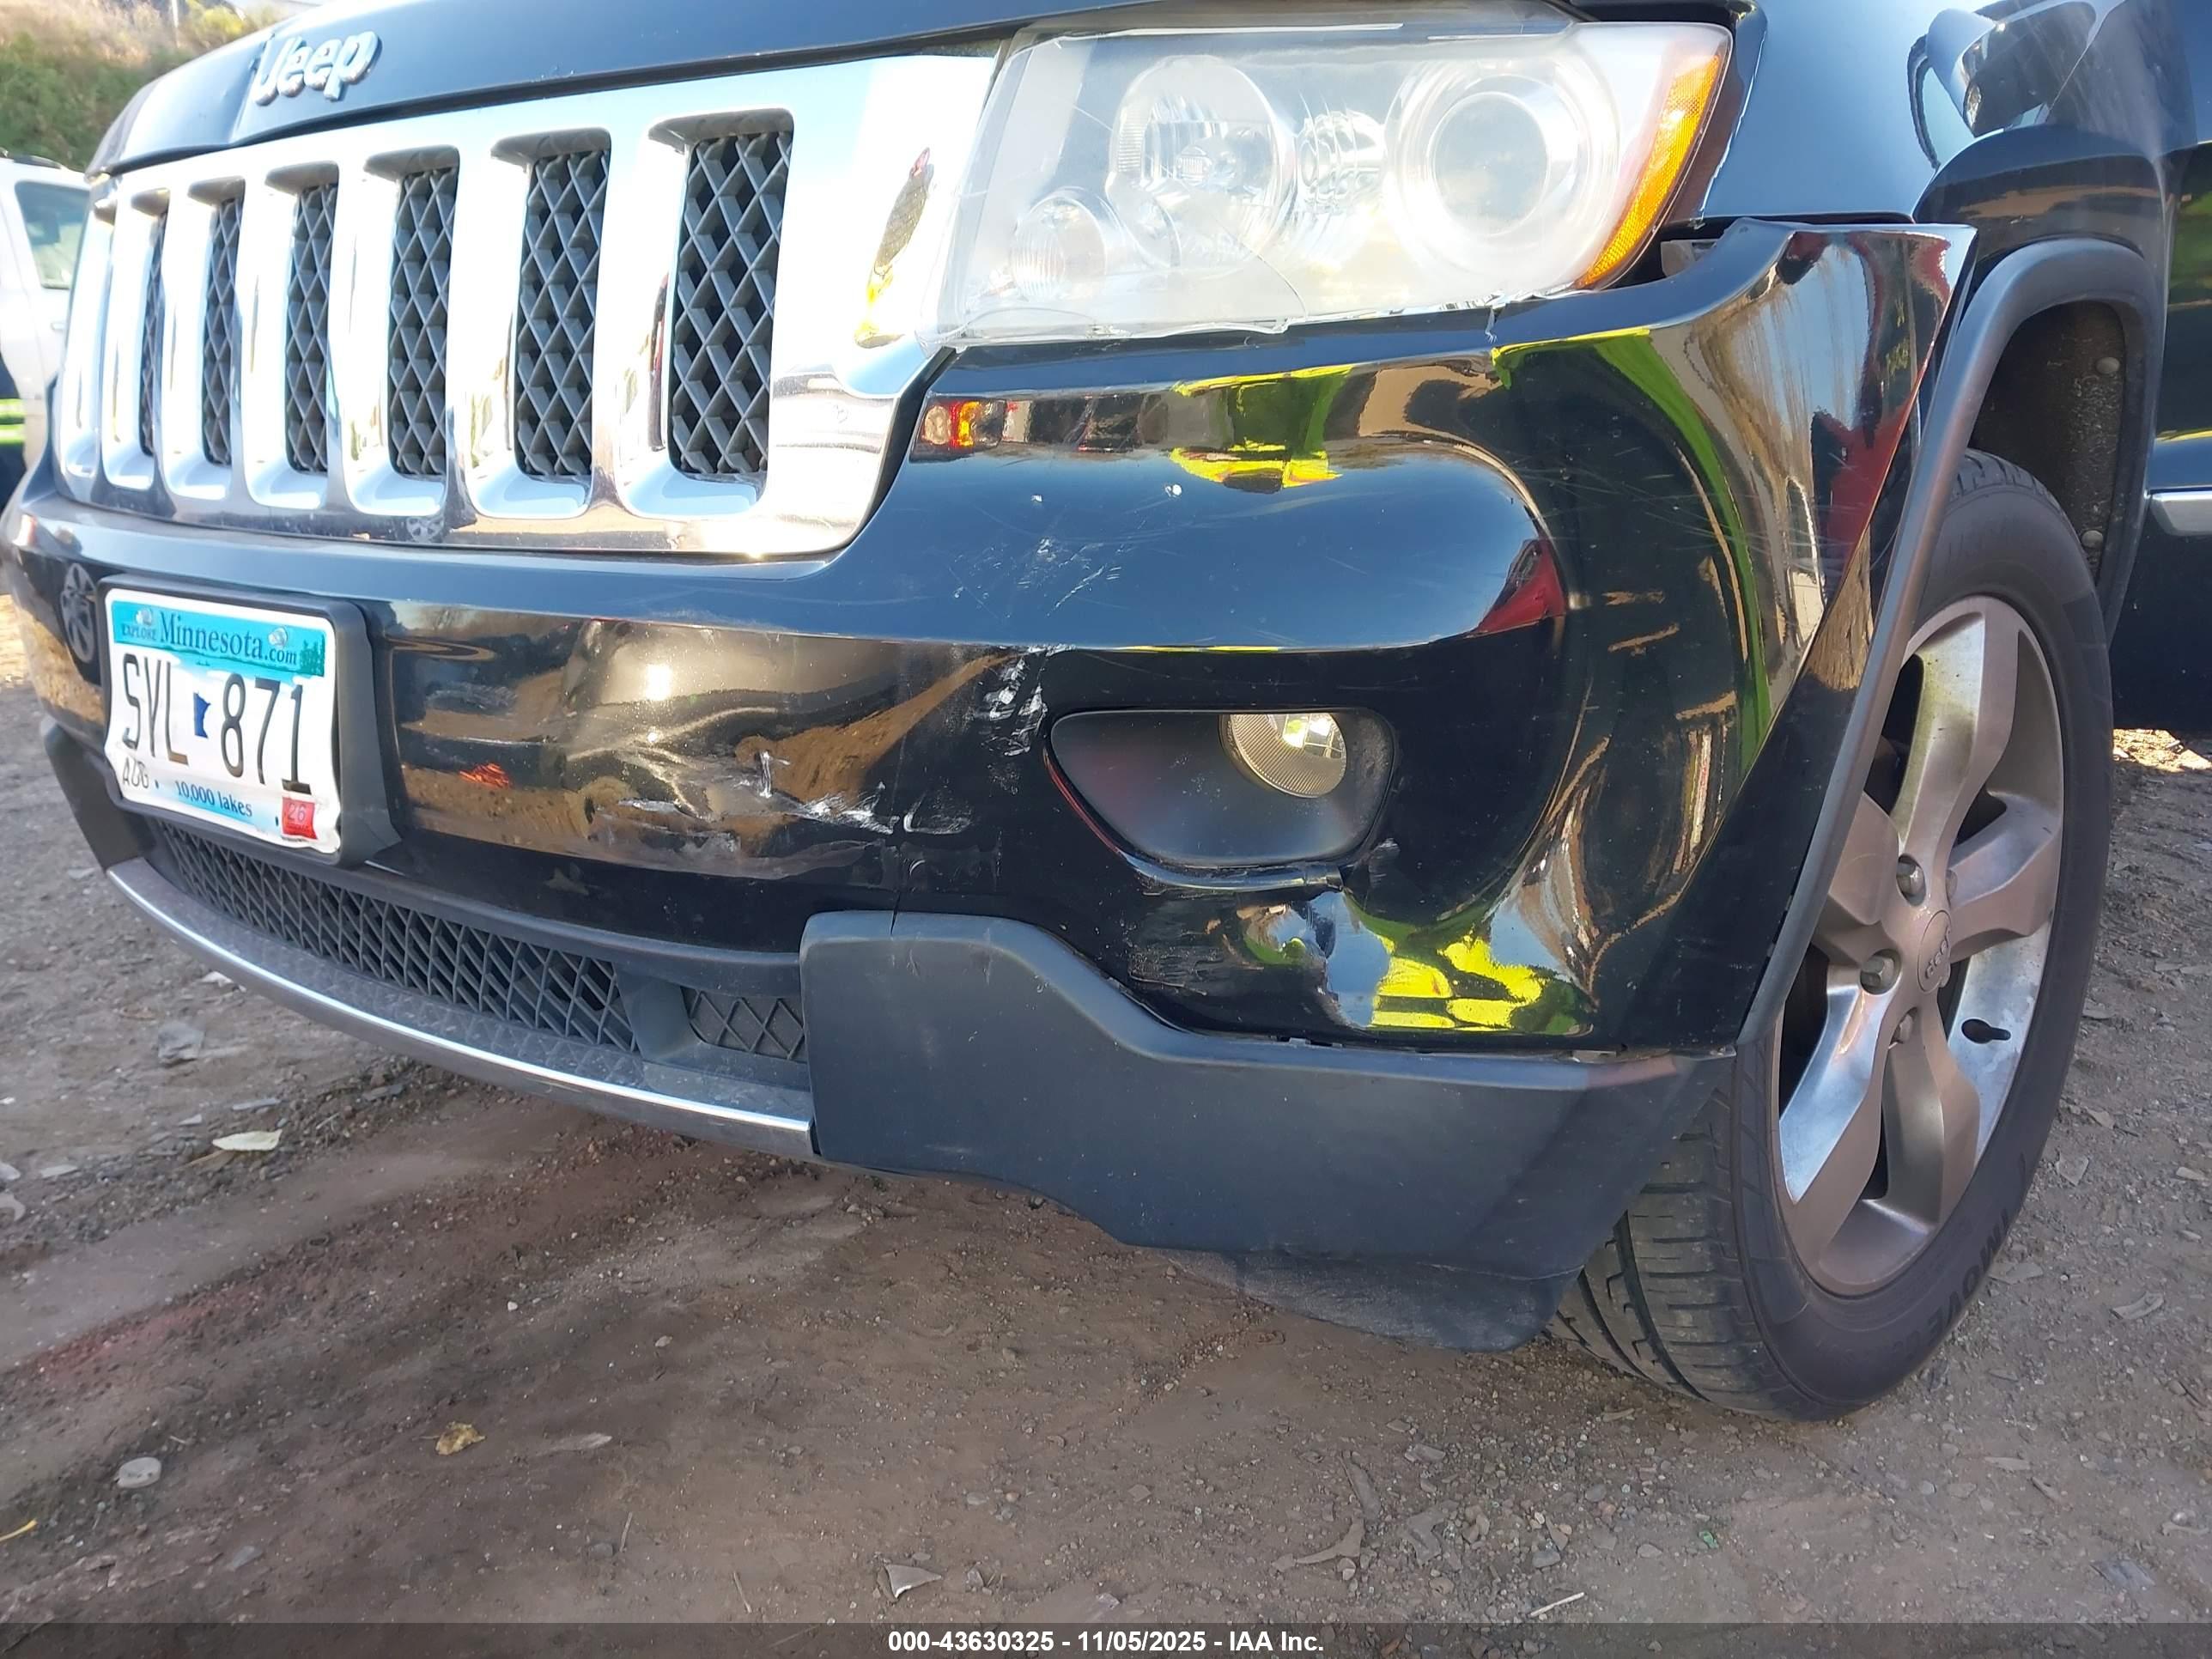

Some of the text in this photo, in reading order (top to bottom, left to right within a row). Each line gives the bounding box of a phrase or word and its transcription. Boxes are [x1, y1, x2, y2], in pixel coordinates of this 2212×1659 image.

[250, 31, 382, 106] Jeep
[221, 672, 312, 795] 871
[123, 757, 149, 789] AUG
[175, 780, 253, 817] 10,000 lakes
[288, 802, 307, 823] 26
